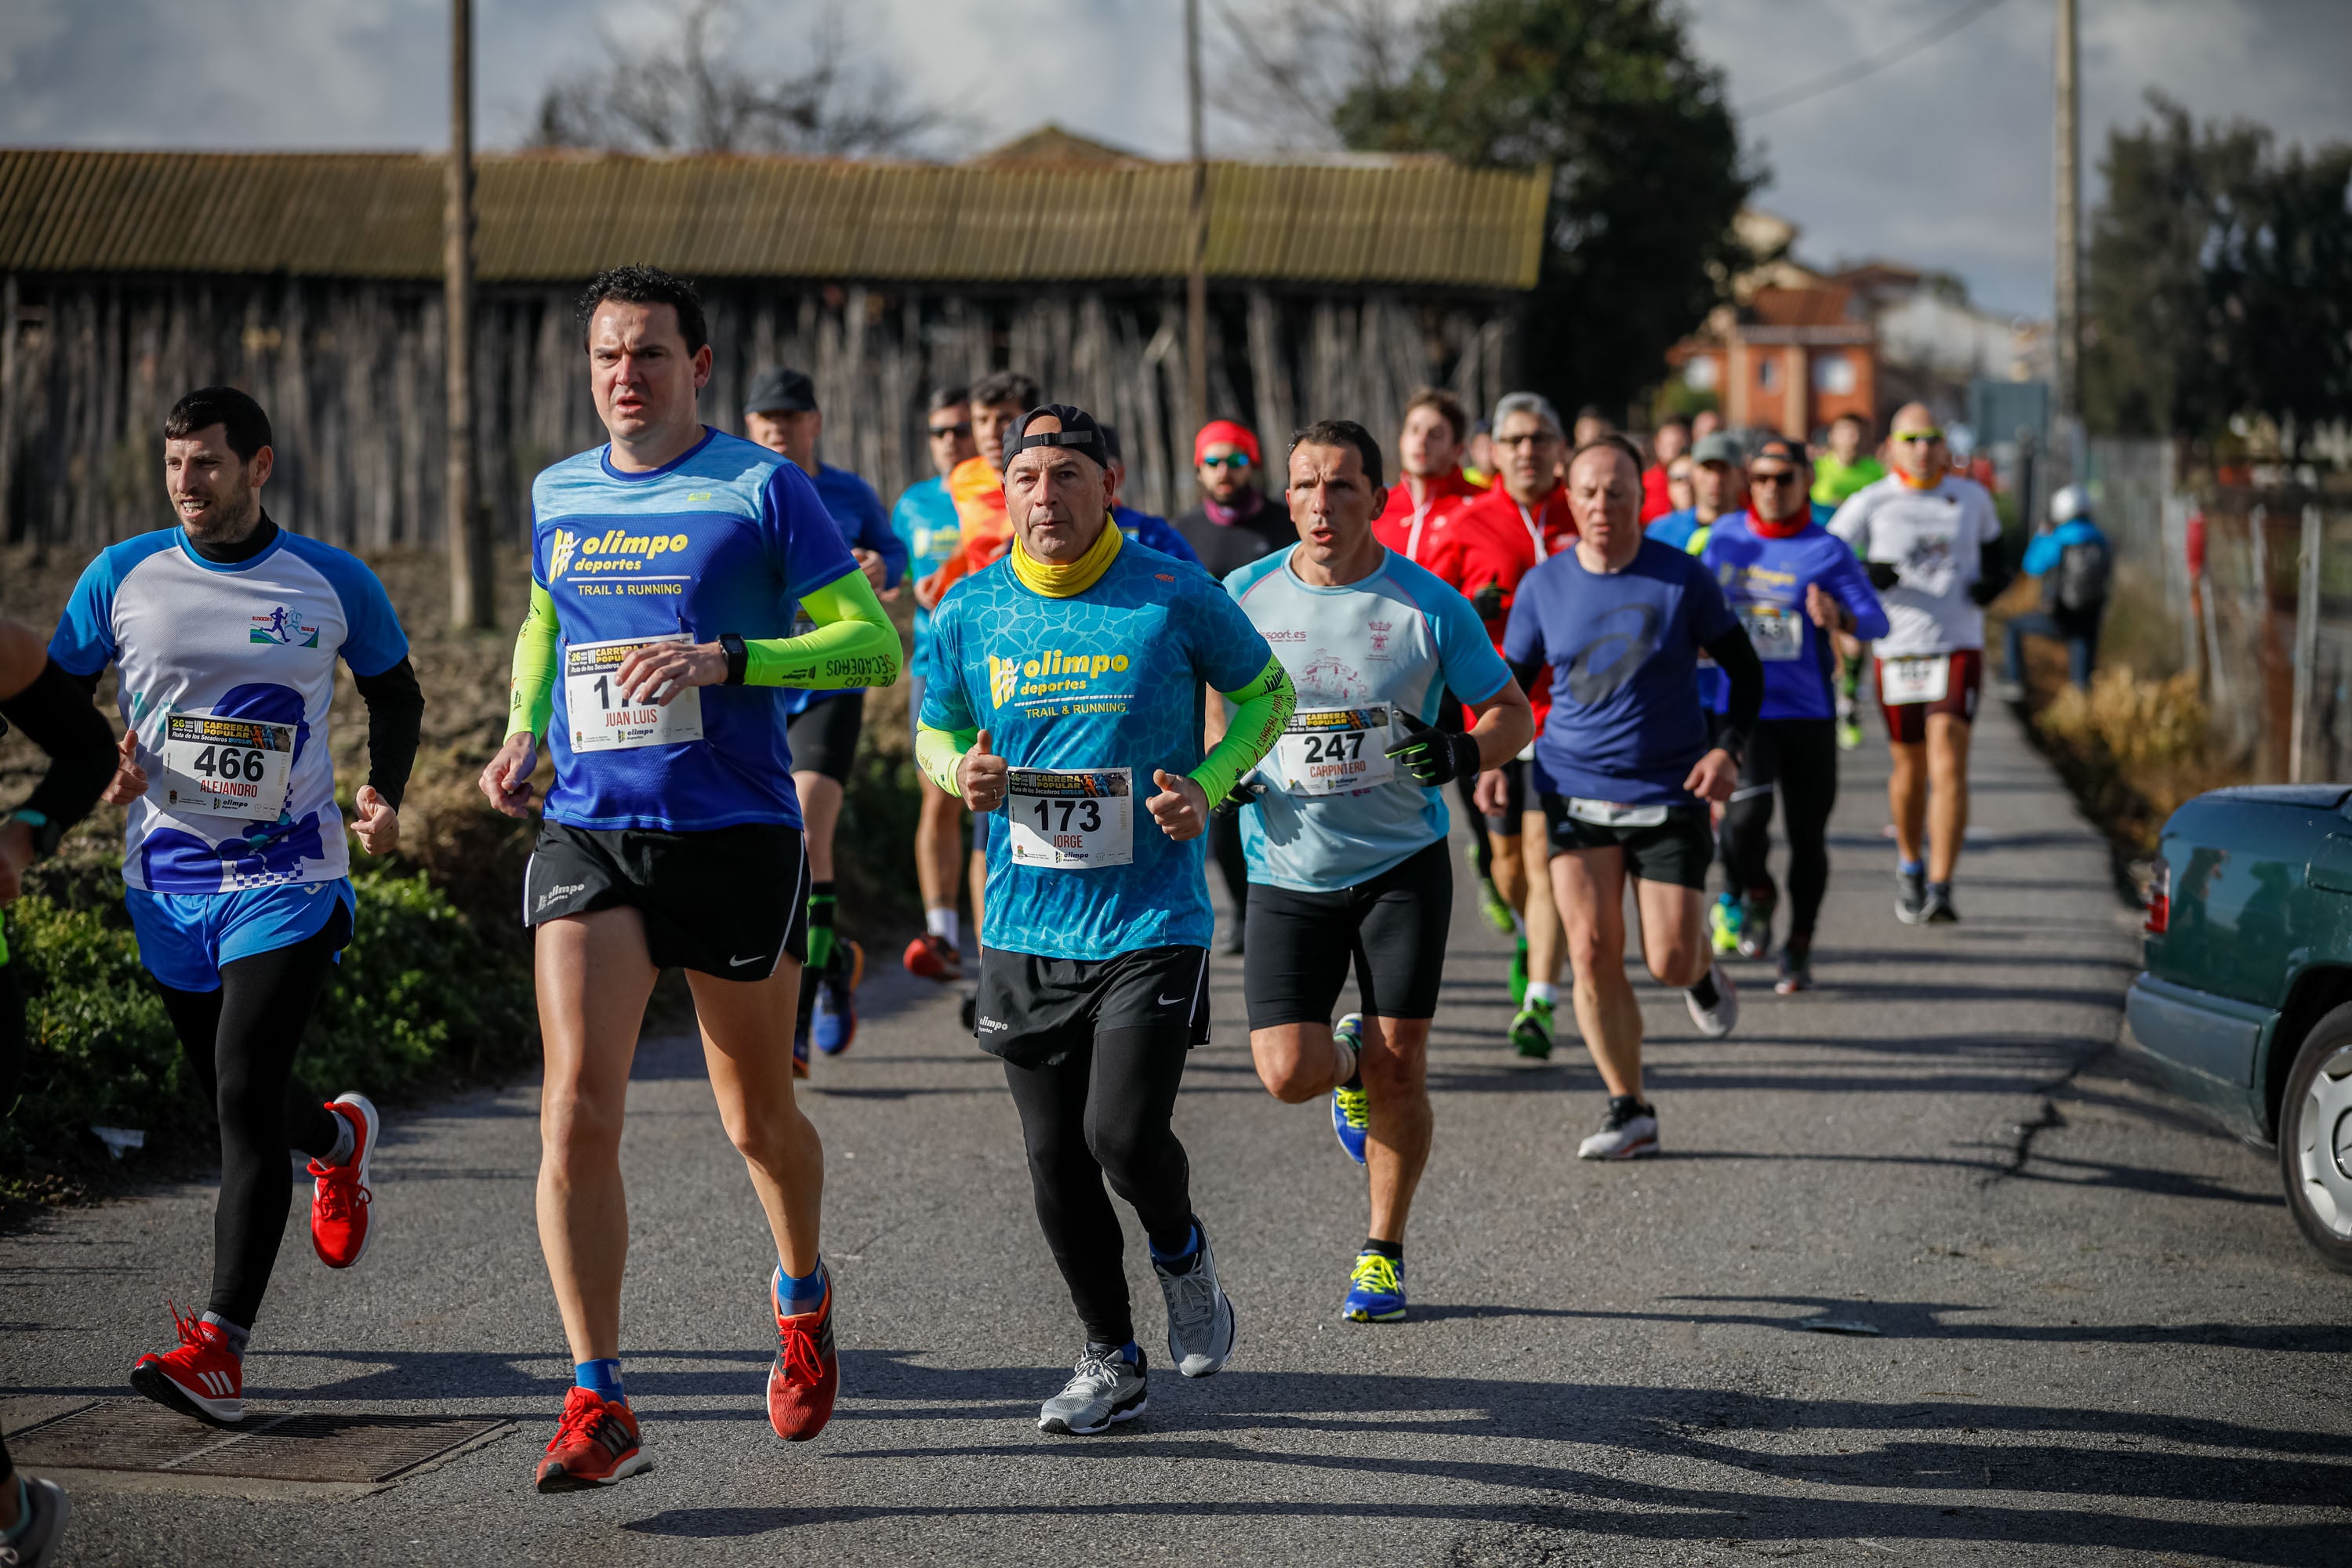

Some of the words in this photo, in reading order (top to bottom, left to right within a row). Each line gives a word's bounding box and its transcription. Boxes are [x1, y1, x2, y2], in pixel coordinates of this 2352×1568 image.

[583, 530, 688, 560] olimpo
[574, 558, 641, 574] deportes
[578, 585, 612, 595] TRAIL
[615, 585, 624, 595] &
[628, 583, 682, 595] RUNNING
[571, 652, 581, 662] 26
[826, 654, 895, 676] SECADEROS
[1024, 649, 1129, 679] olimpo
[1021, 679, 1087, 696] deportes
[605, 712, 630, 728] JUAN
[633, 709, 657, 724] LUIS
[1025, 707, 1058, 719] TRAIL
[1062, 706, 1069, 715] &
[1073, 702, 1126, 713] RUNNING
[1306, 712, 1347, 720] CARRERA
[172, 719, 185, 728] 26
[194, 720, 204, 734] VII
[204, 721, 250, 732] CARRERA
[1256, 715, 1279, 748] CARRERA
[204, 729, 249, 739] POPULAR
[1305, 731, 1365, 764] 247
[194, 746, 264, 782] 466
[1310, 760, 1366, 778] CARPINTERO
[200, 780, 257, 797] ALEJANDRO
[1035, 800, 1102, 832] 173
[1054, 835, 1083, 848] JORGE
[548, 884, 585, 899] olimpo
